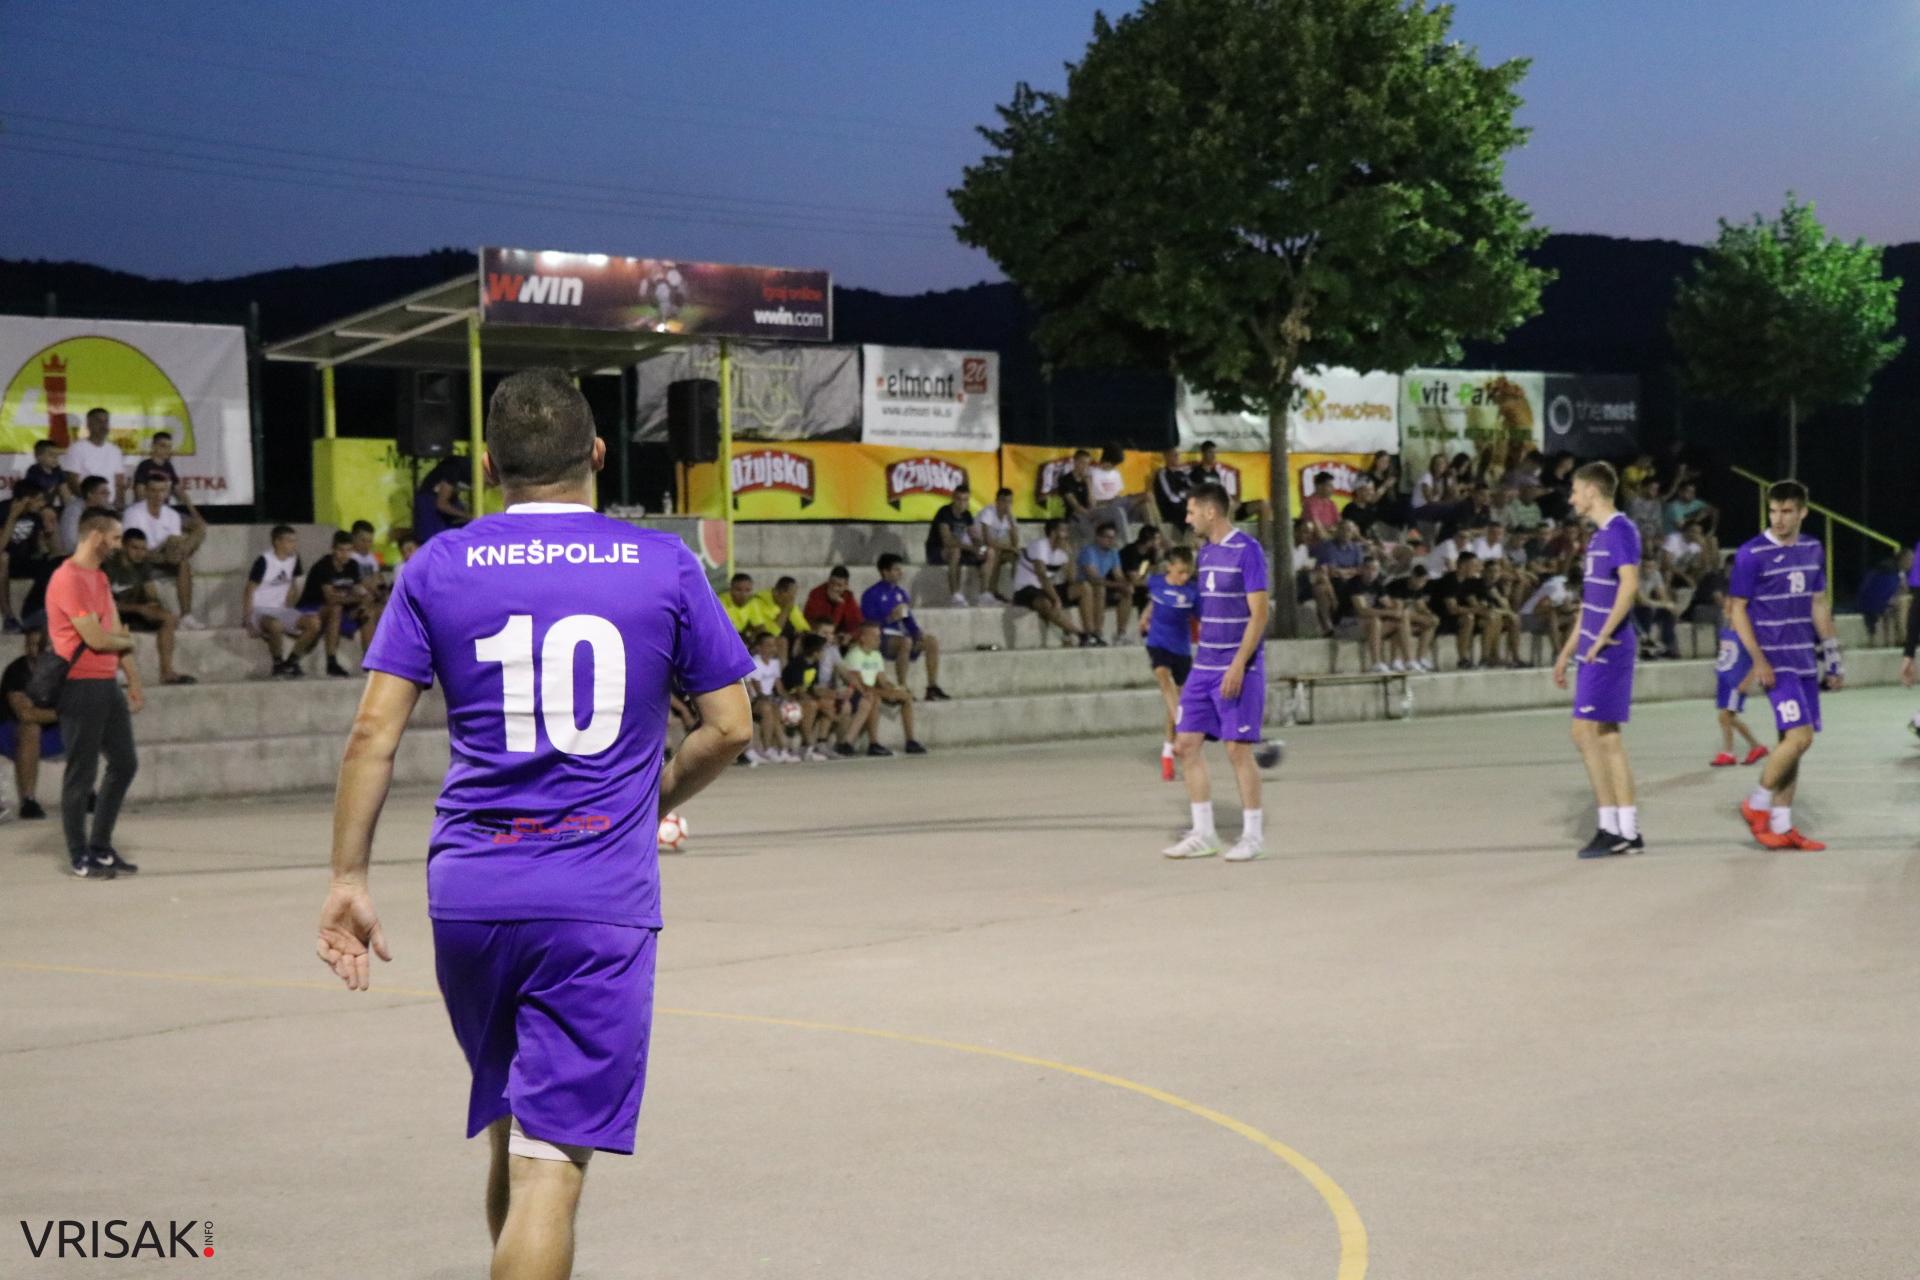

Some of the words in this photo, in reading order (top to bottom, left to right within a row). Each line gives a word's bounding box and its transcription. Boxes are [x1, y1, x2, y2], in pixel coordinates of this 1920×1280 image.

[753, 306, 824, 328] wwin.com
[887, 369, 955, 399] elmont
[466, 539, 640, 567] KNEŠPOLJE
[1206, 571, 1216, 592] 4
[1787, 571, 1806, 593] 19
[475, 614, 627, 756] 10
[1777, 699, 1801, 723] 19
